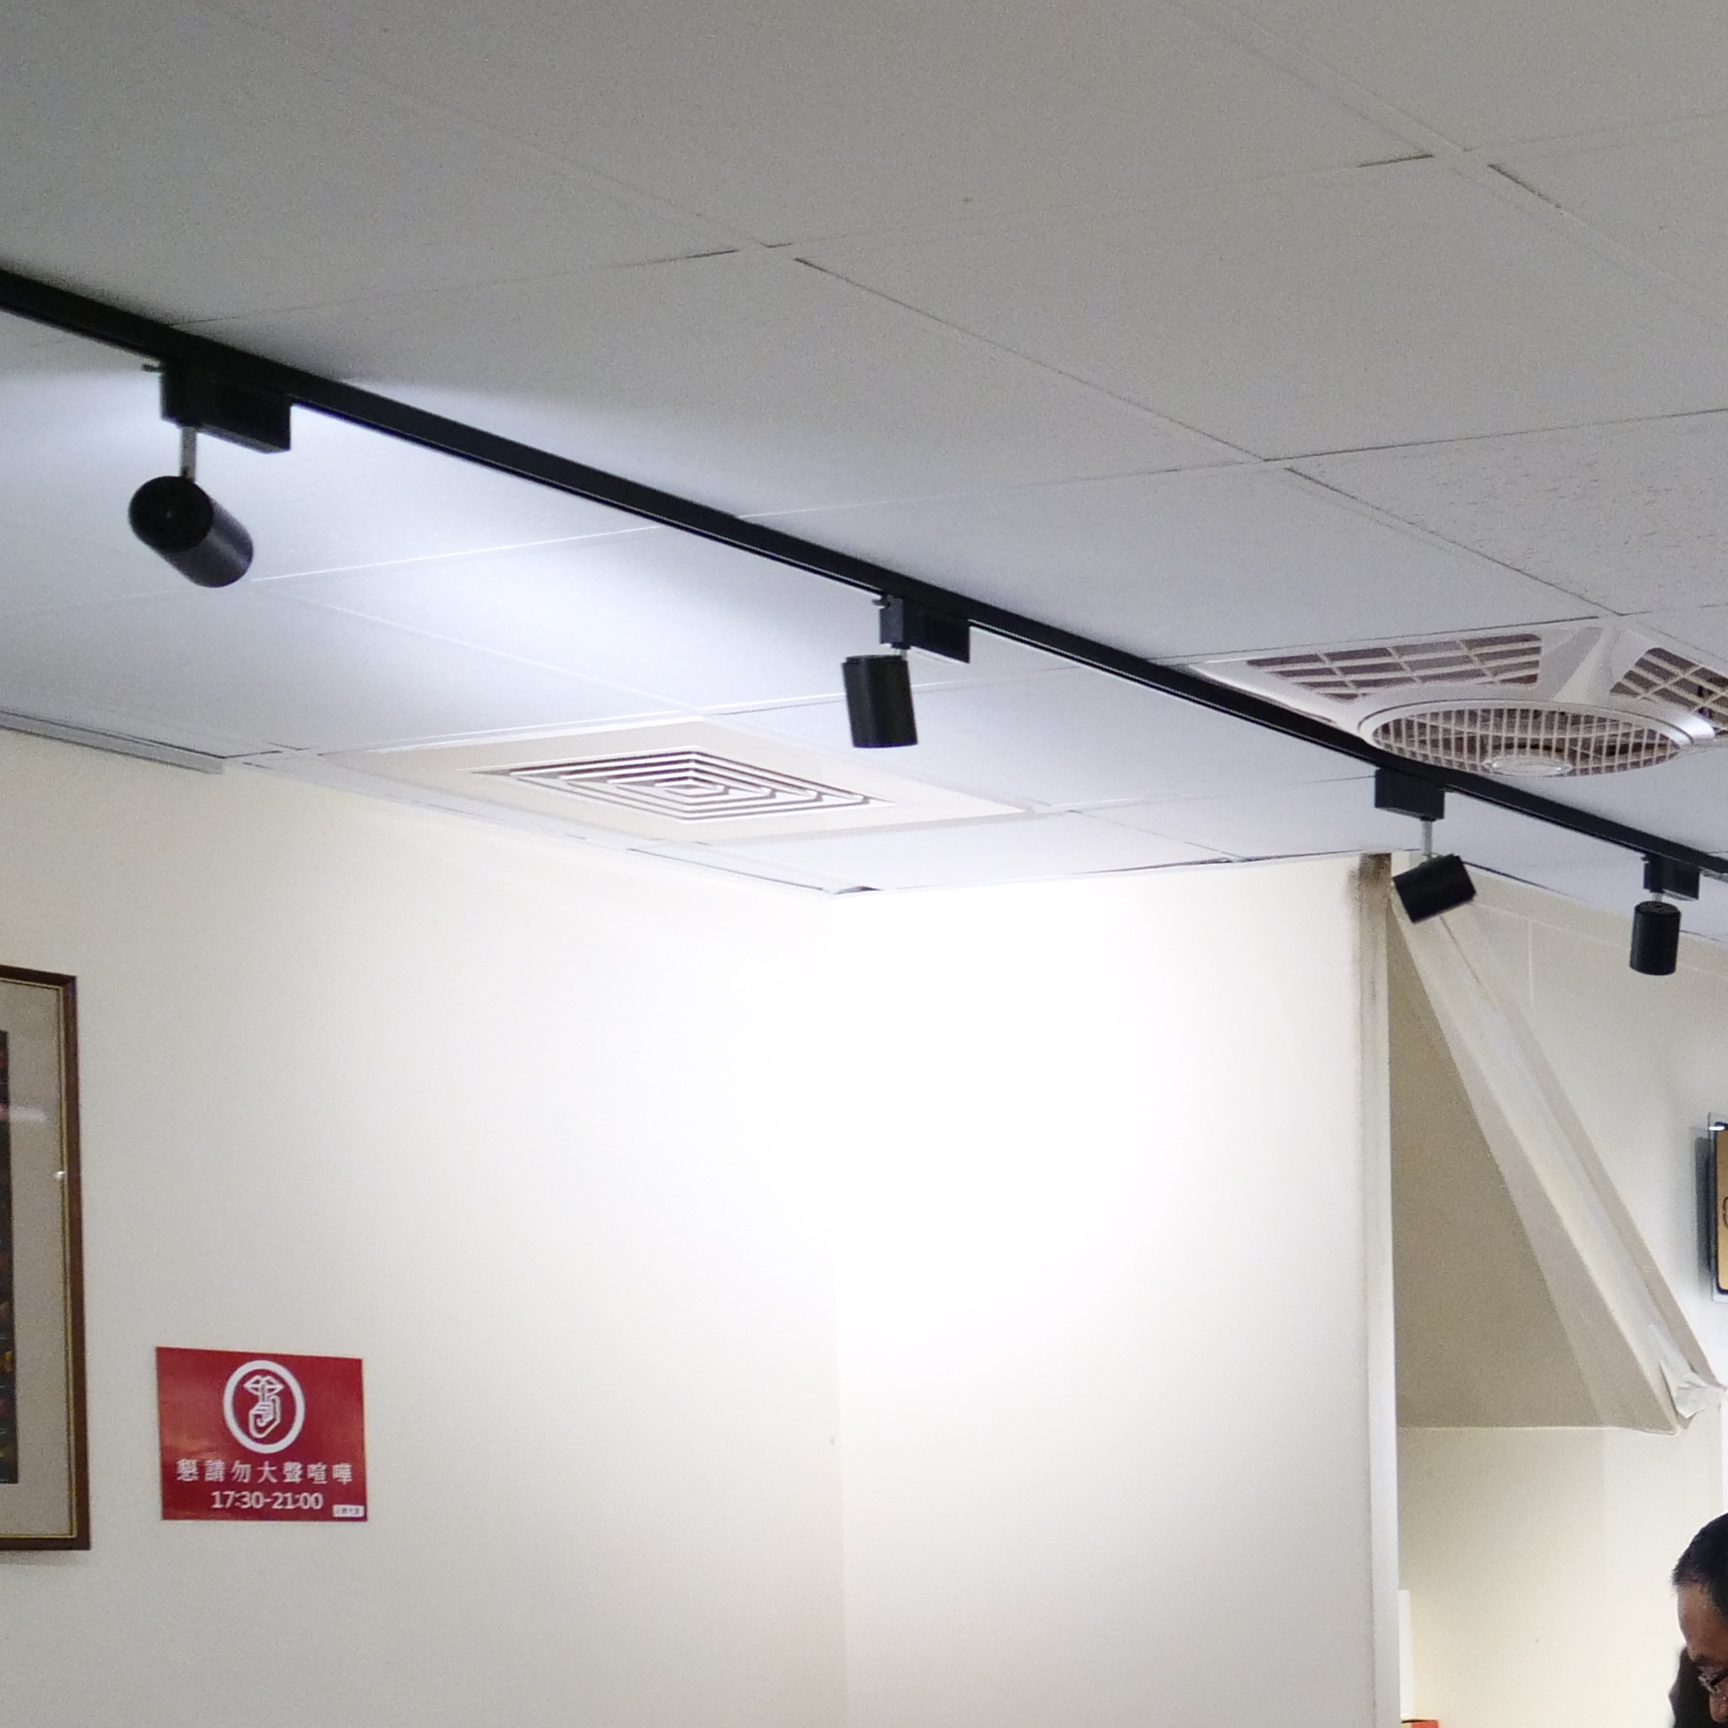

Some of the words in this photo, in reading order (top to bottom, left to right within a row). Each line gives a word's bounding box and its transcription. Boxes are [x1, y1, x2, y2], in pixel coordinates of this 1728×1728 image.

[176, 1458, 353, 1485] 懇請勿大聲喧嘩
[211, 1490, 324, 1510] 17:30-21:00
